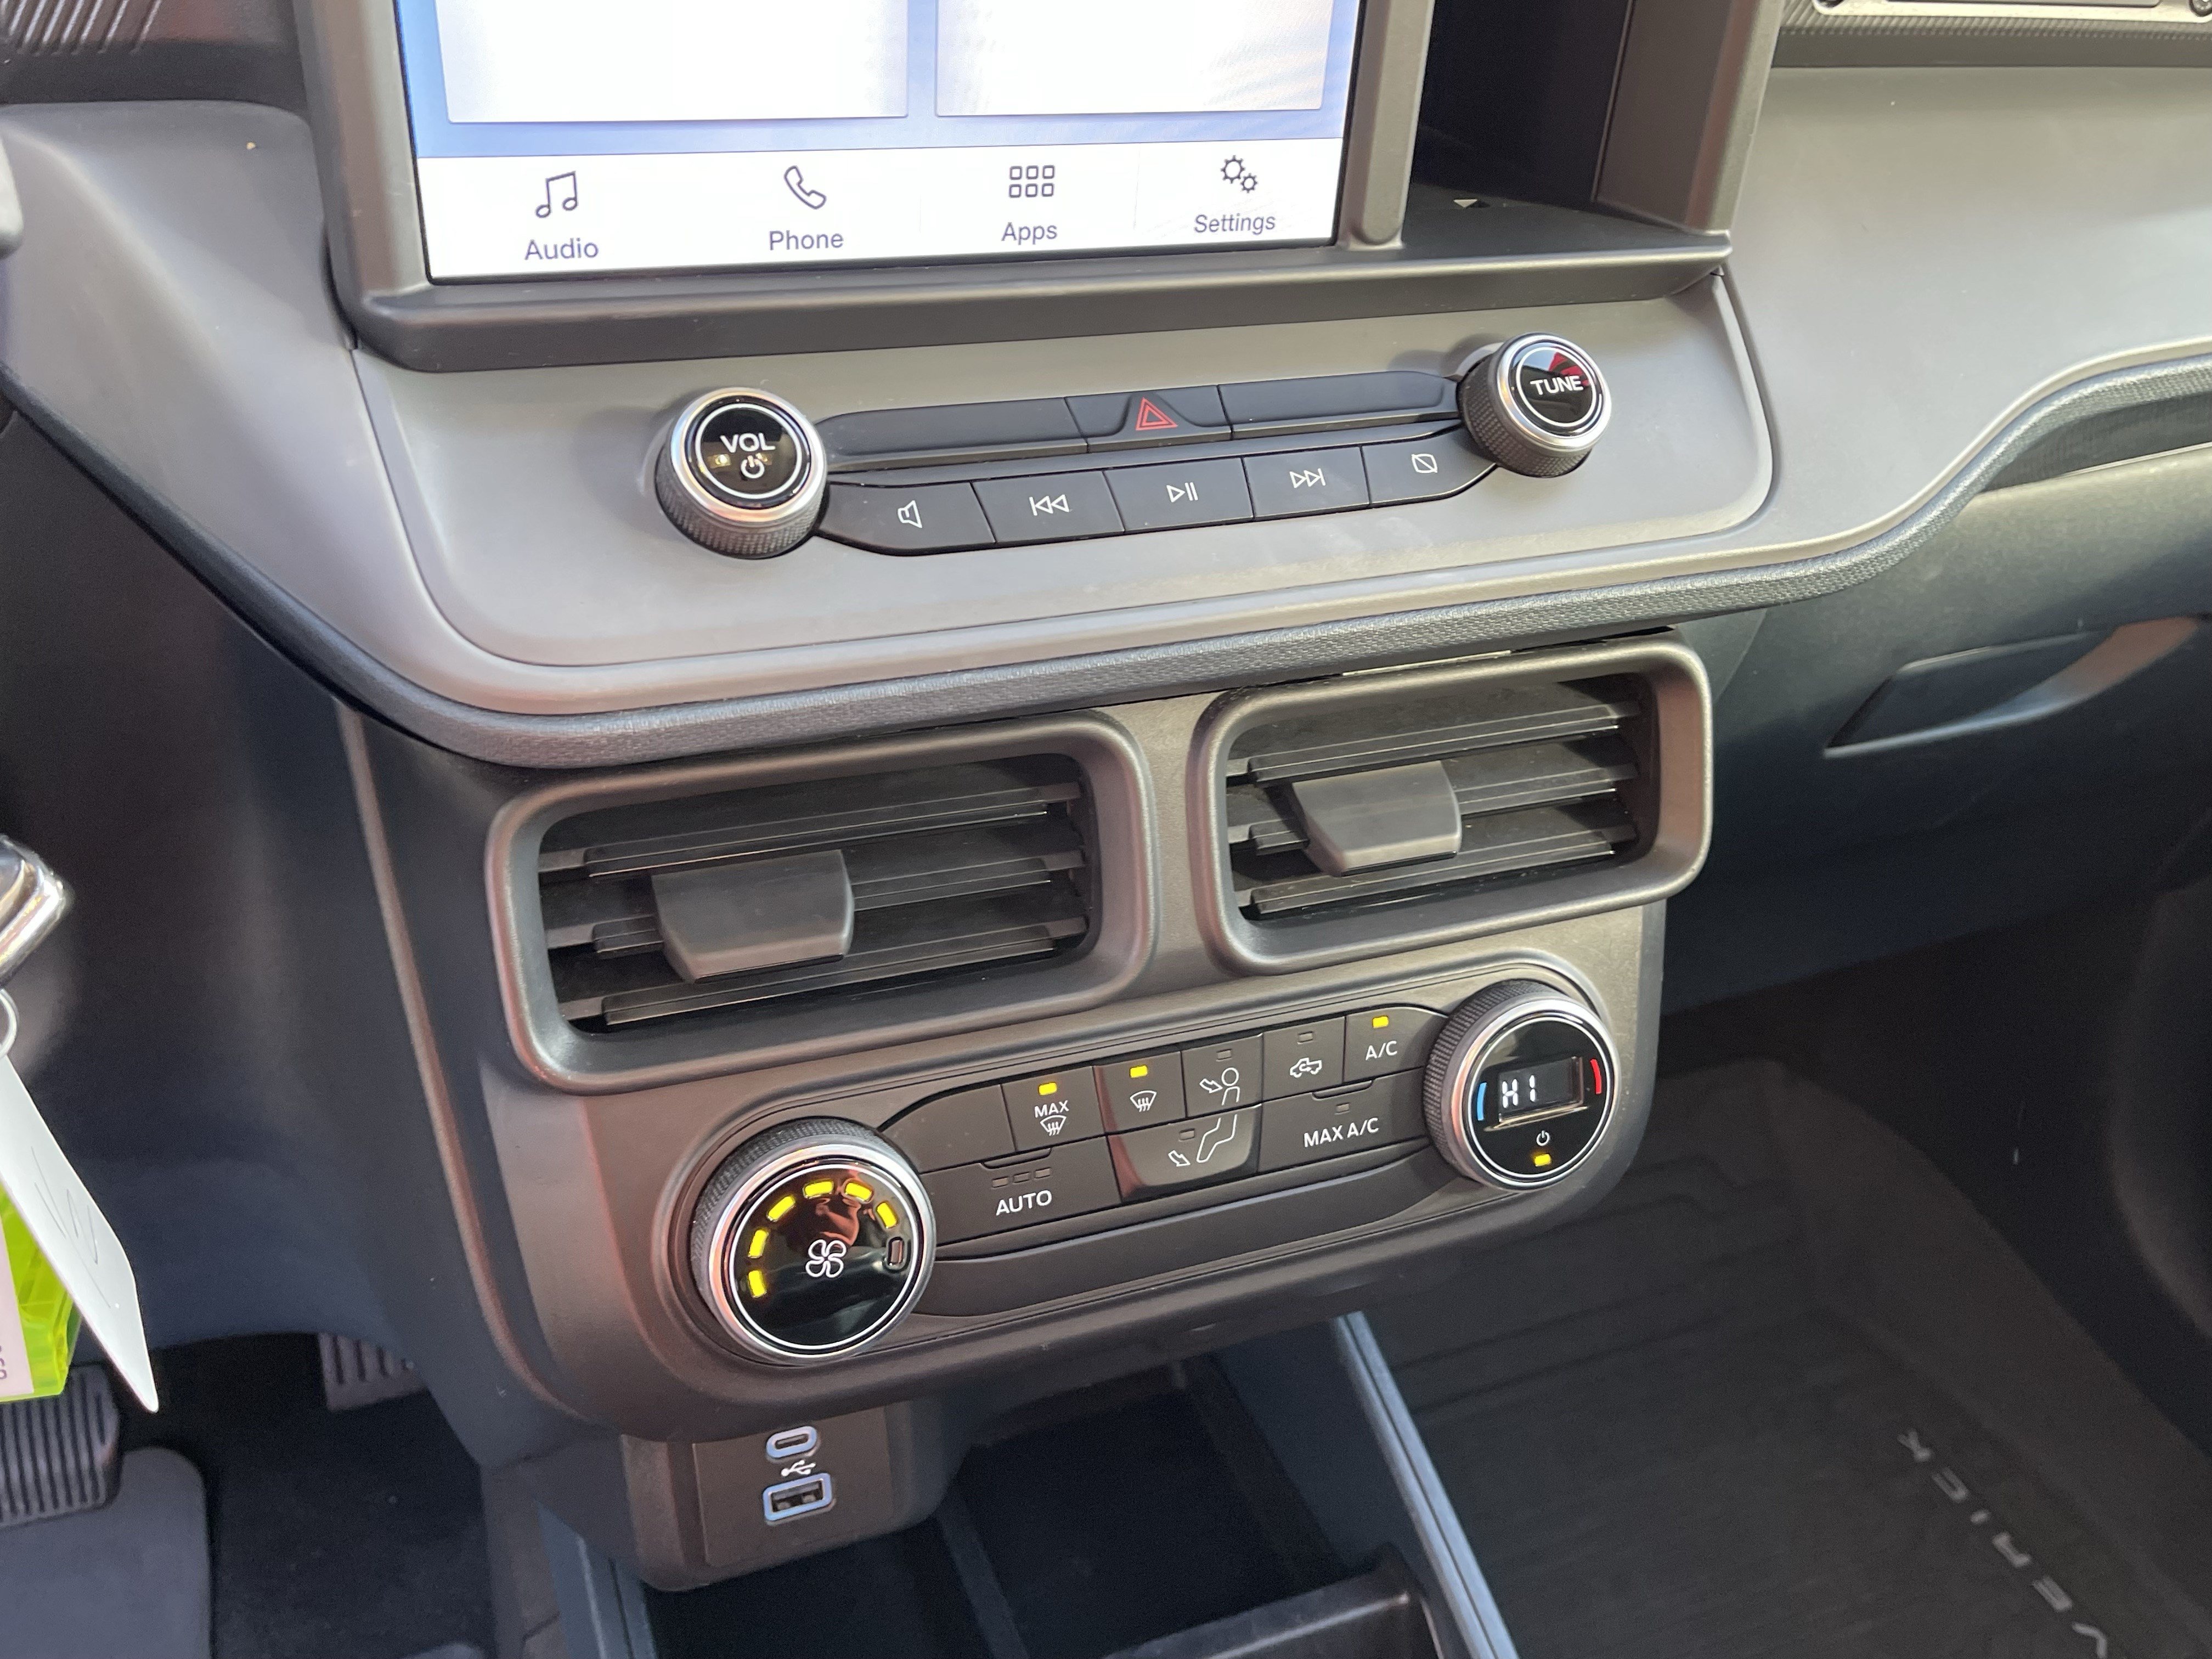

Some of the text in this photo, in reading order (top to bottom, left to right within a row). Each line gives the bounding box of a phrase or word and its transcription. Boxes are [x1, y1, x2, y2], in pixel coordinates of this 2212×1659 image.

[1001, 222, 1058, 245] Apps
[1194, 212, 1276, 235] Settings
[524, 237, 599, 261] Audio
[769, 230, 844, 251] Phone
[1530, 375, 1584, 396] TUNE
[720, 433, 776, 453] VOL
[1365, 1040, 1398, 1060] A/C
[1034, 1100, 1069, 1118] MAX
[1304, 1118, 1379, 1148] MAX A/C
[996, 1190, 1052, 1216] AUTO
